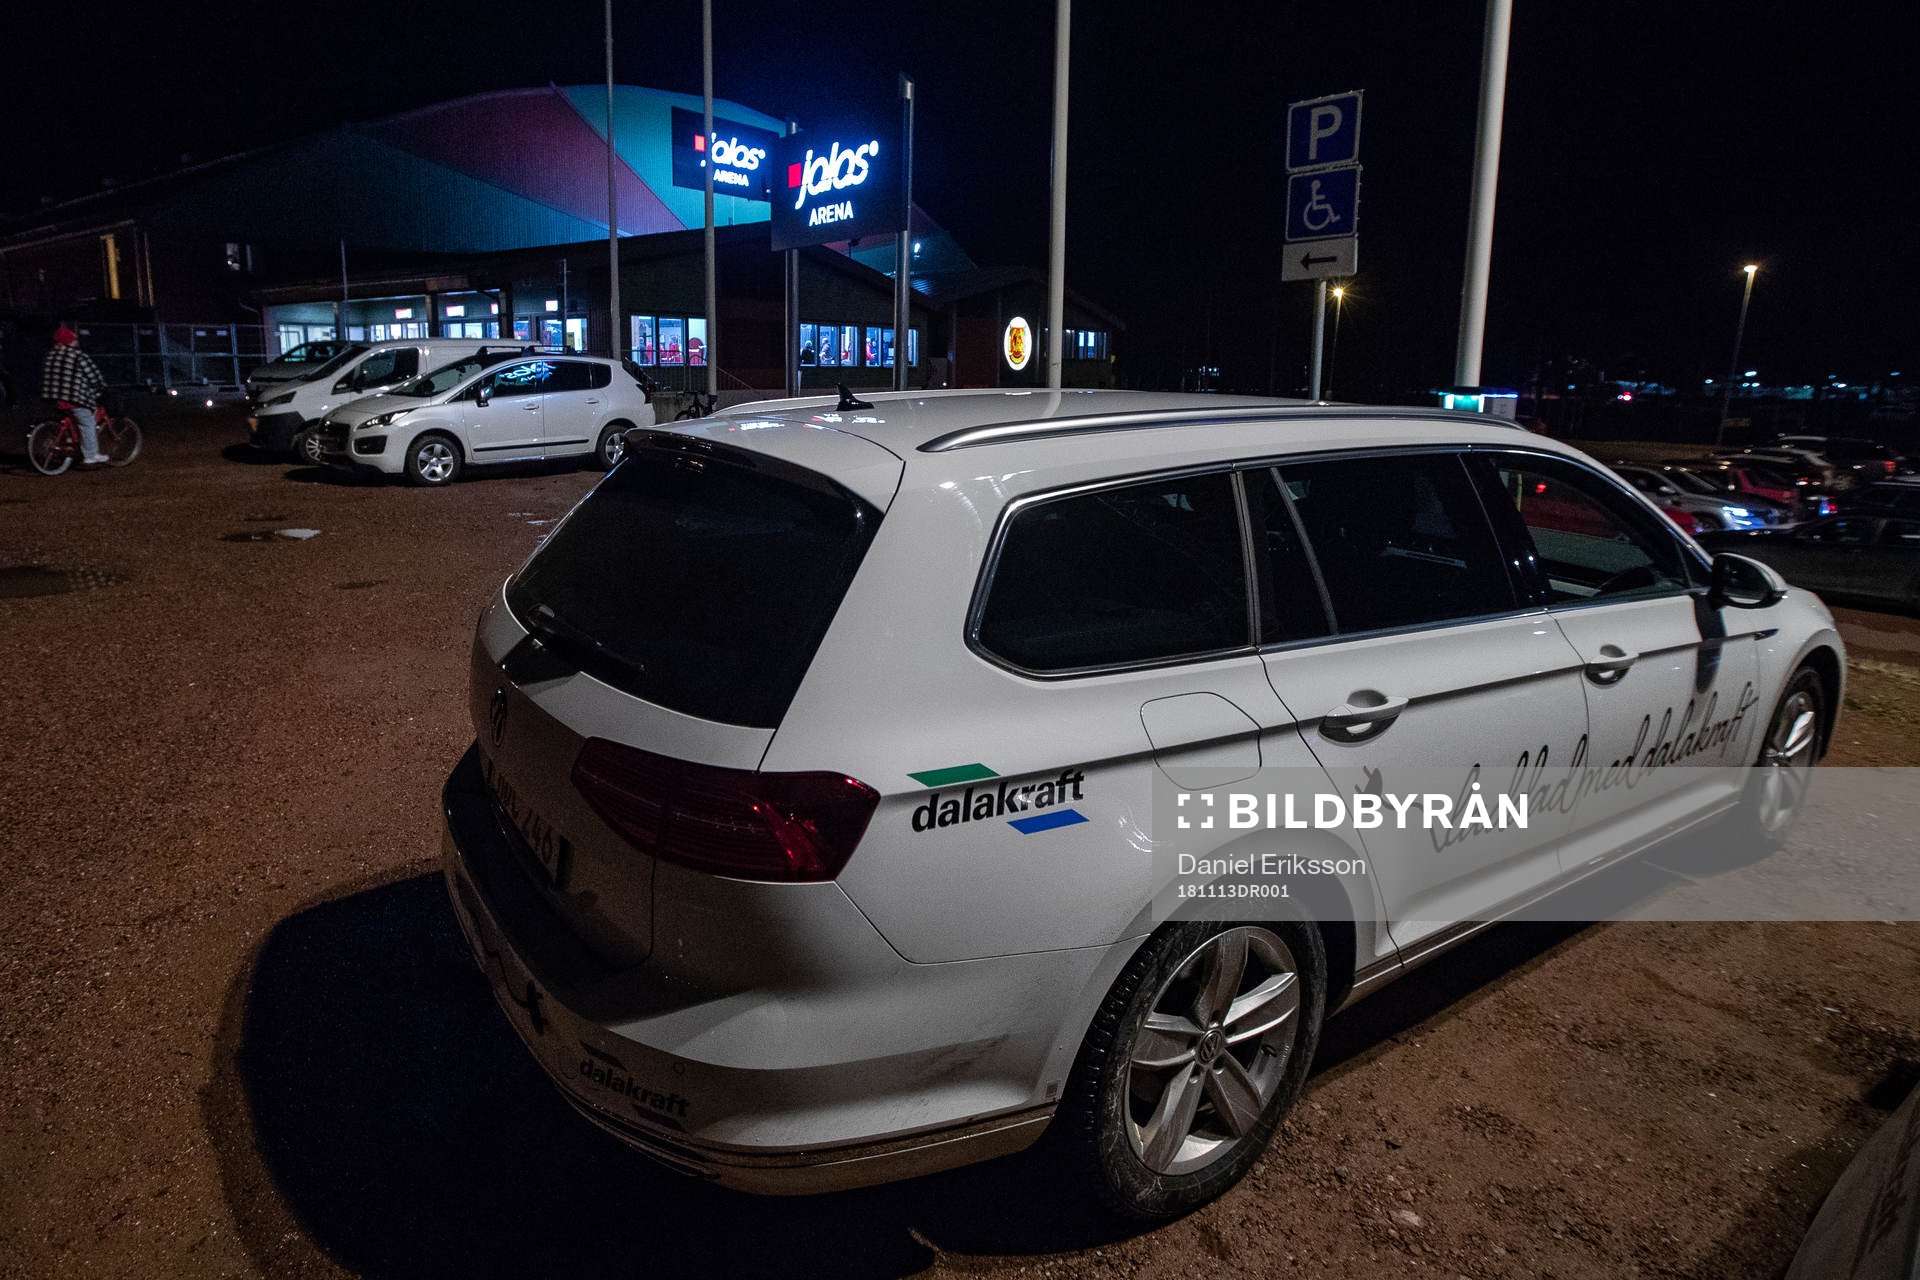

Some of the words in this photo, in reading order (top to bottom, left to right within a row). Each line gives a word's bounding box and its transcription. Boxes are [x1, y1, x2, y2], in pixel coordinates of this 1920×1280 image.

[700, 132, 766, 171] alas
[1308, 104, 1343, 161] P
[713, 168, 750, 187] ARENA
[808, 200, 854, 227] ARENA
[911, 768, 1085, 833] dalakraft
[580, 1059, 690, 1118] dalakraft
